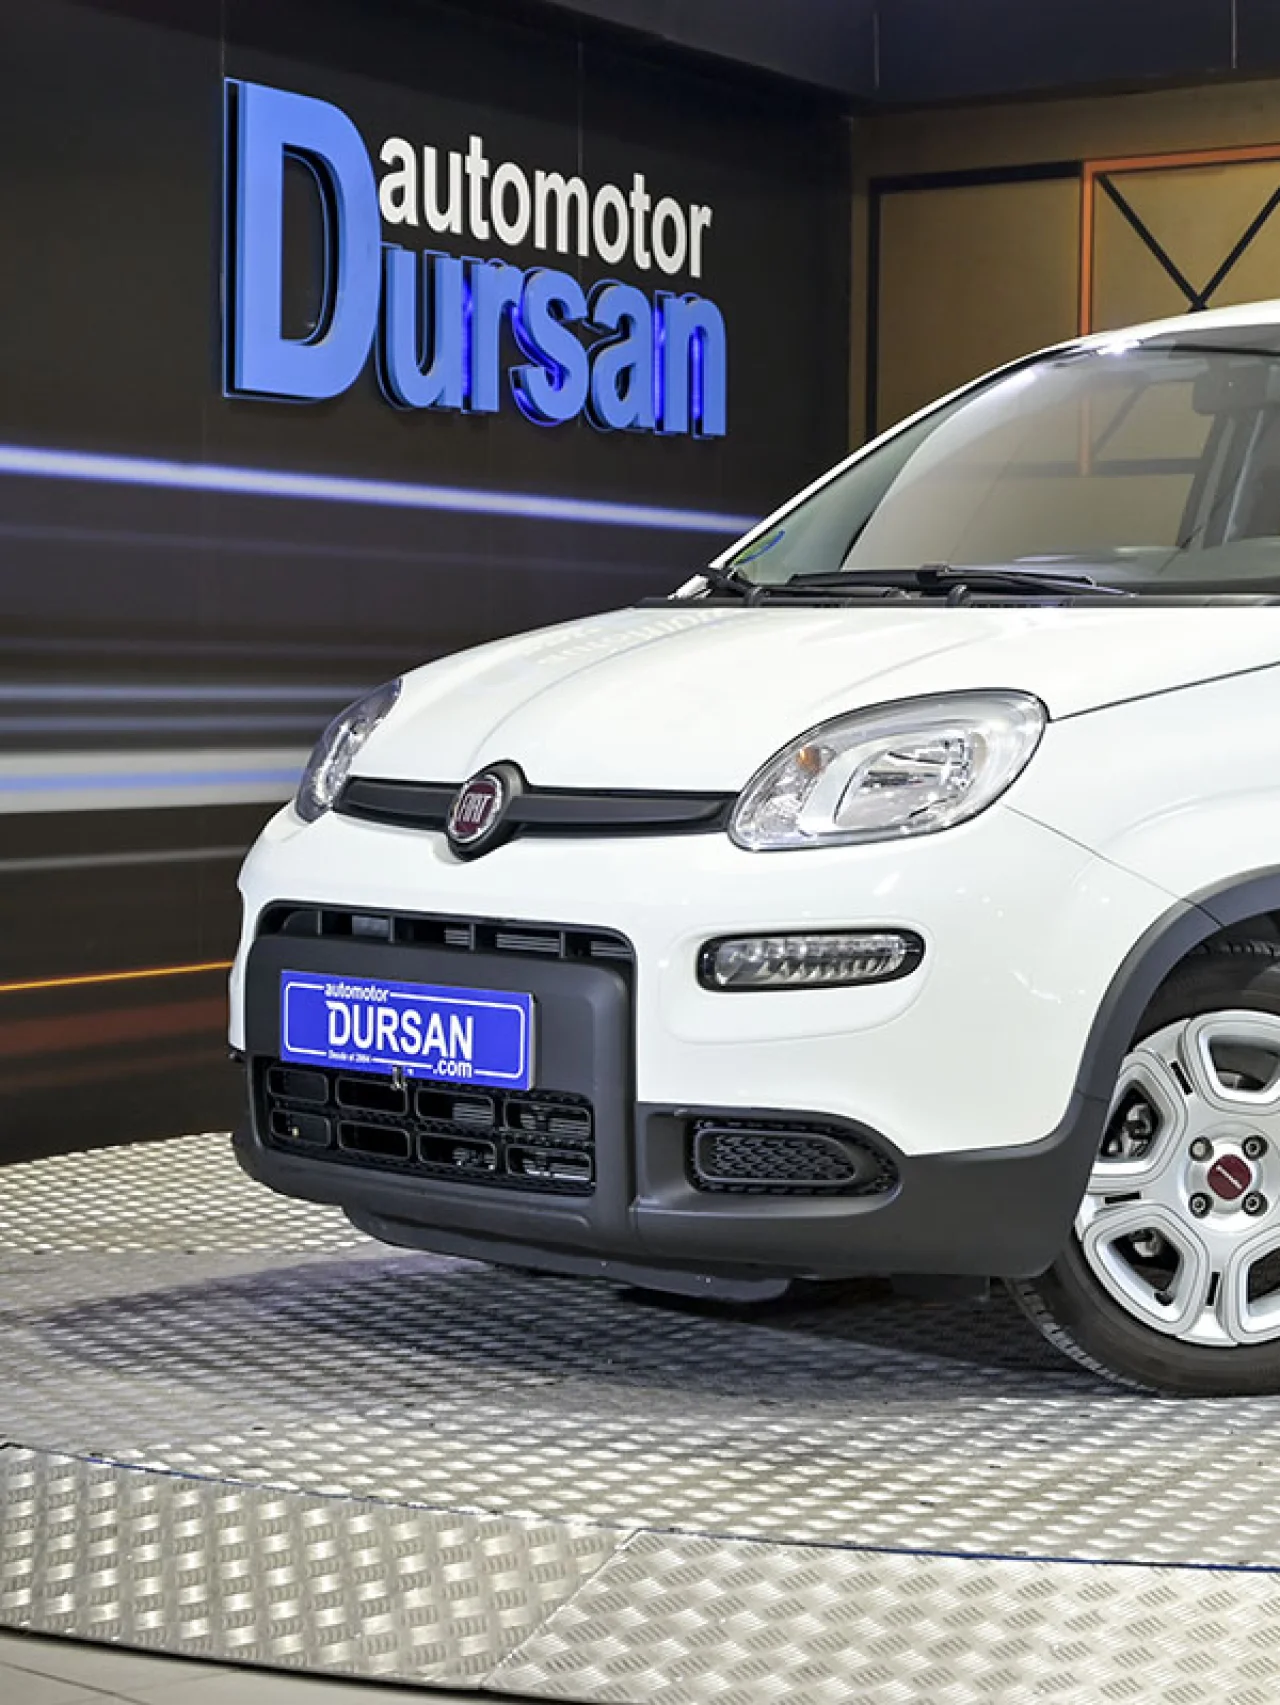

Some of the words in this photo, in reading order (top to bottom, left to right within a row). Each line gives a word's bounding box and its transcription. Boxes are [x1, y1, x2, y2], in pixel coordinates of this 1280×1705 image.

[378, 134, 712, 278] automotor
[223, 76, 727, 438] Dursan
[452, 793, 493, 824] FIAT
[325, 982, 388, 1003] automotor
[325, 1000, 473, 1061] DURSAN
[432, 1059, 472, 1078] .com
